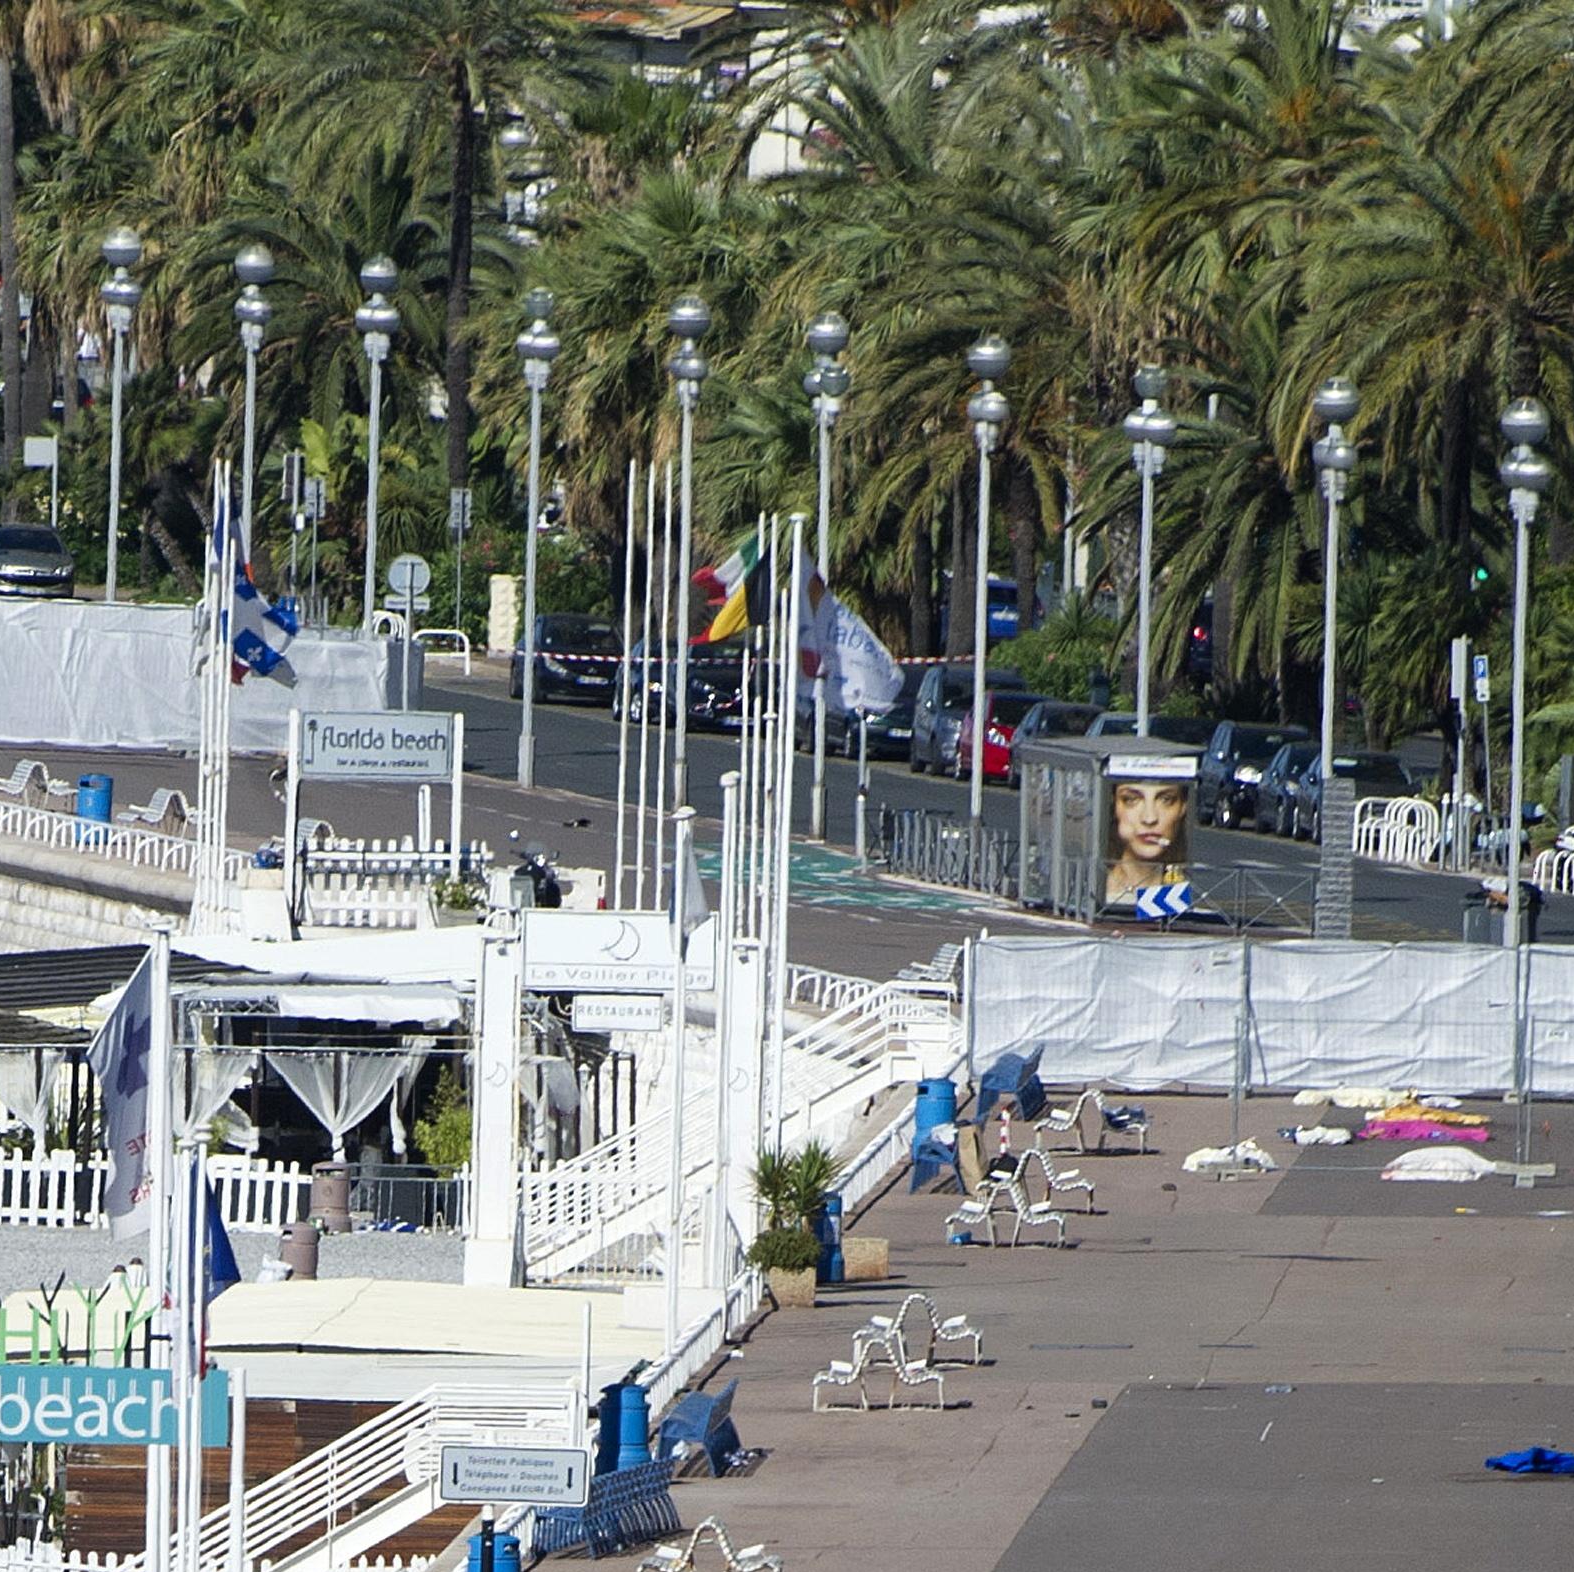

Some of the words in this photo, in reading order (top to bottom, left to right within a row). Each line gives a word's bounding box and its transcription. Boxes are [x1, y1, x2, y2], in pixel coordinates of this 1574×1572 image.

[321, 726, 385, 751] florida
[392, 728, 446, 751] beach
[531, 969, 557, 979] Le
[566, 969, 636, 982] Voilier
[577, 1004, 661, 1018] RESTAURANT
